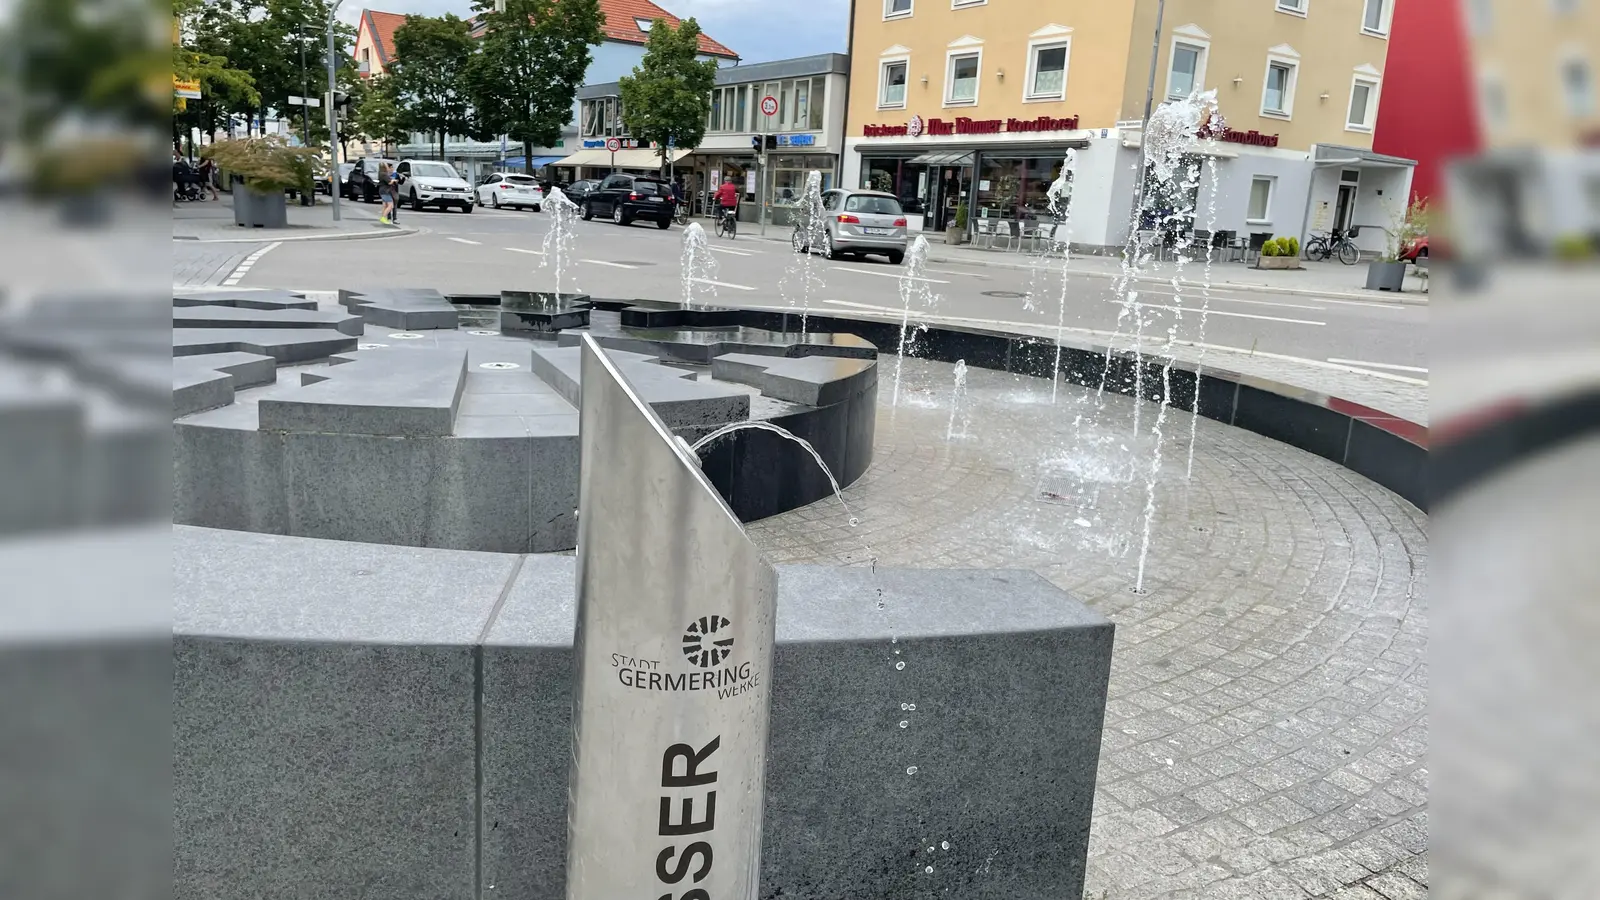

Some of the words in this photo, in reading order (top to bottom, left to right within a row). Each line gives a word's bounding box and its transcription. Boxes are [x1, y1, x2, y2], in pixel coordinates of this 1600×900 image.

[1007, 114, 1079, 132] Konditorei
[611, 653, 661, 670] STADT
[618, 661, 751, 691] GERMERING
[718, 672, 760, 700] WERKE
[656, 734, 721, 900] SER
